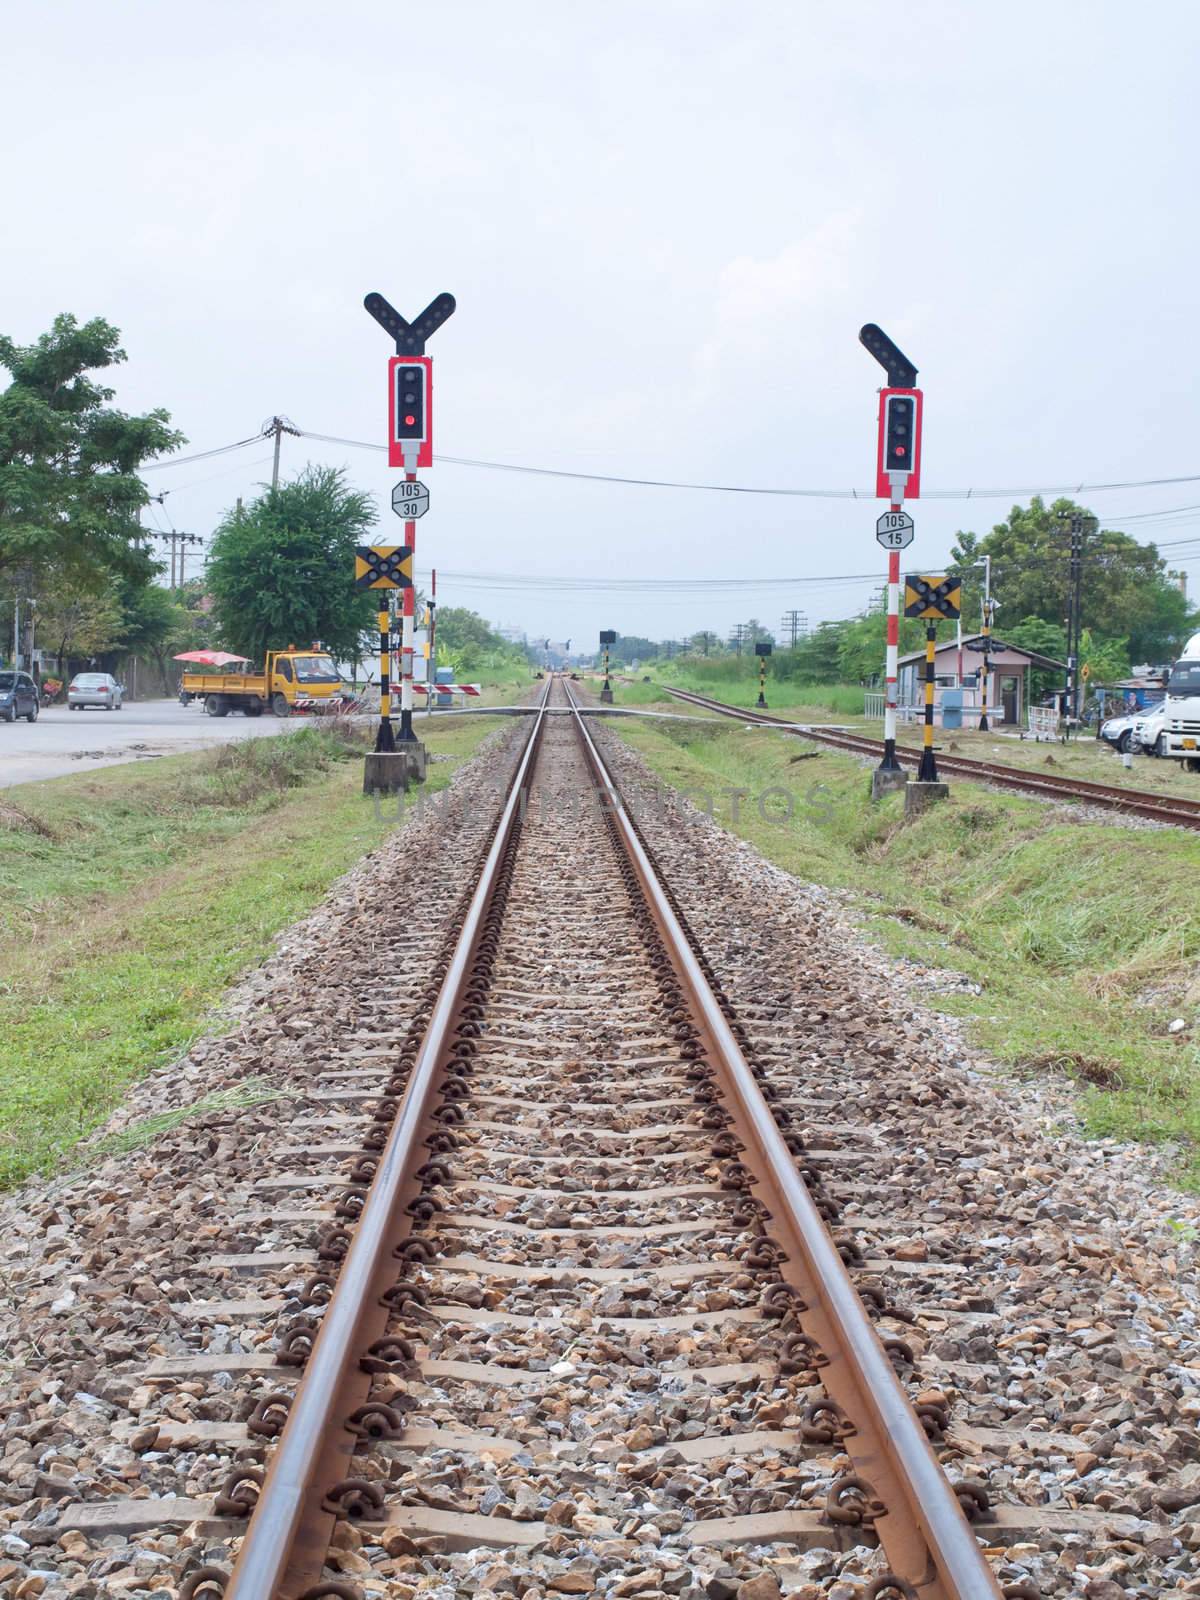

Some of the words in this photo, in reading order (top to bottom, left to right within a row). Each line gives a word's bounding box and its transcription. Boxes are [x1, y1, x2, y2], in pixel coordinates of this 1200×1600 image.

[401, 484, 420, 496] 105
[403, 503, 417, 515] 30
[885, 515, 905, 527] 105
[887, 533, 902, 545] 15
